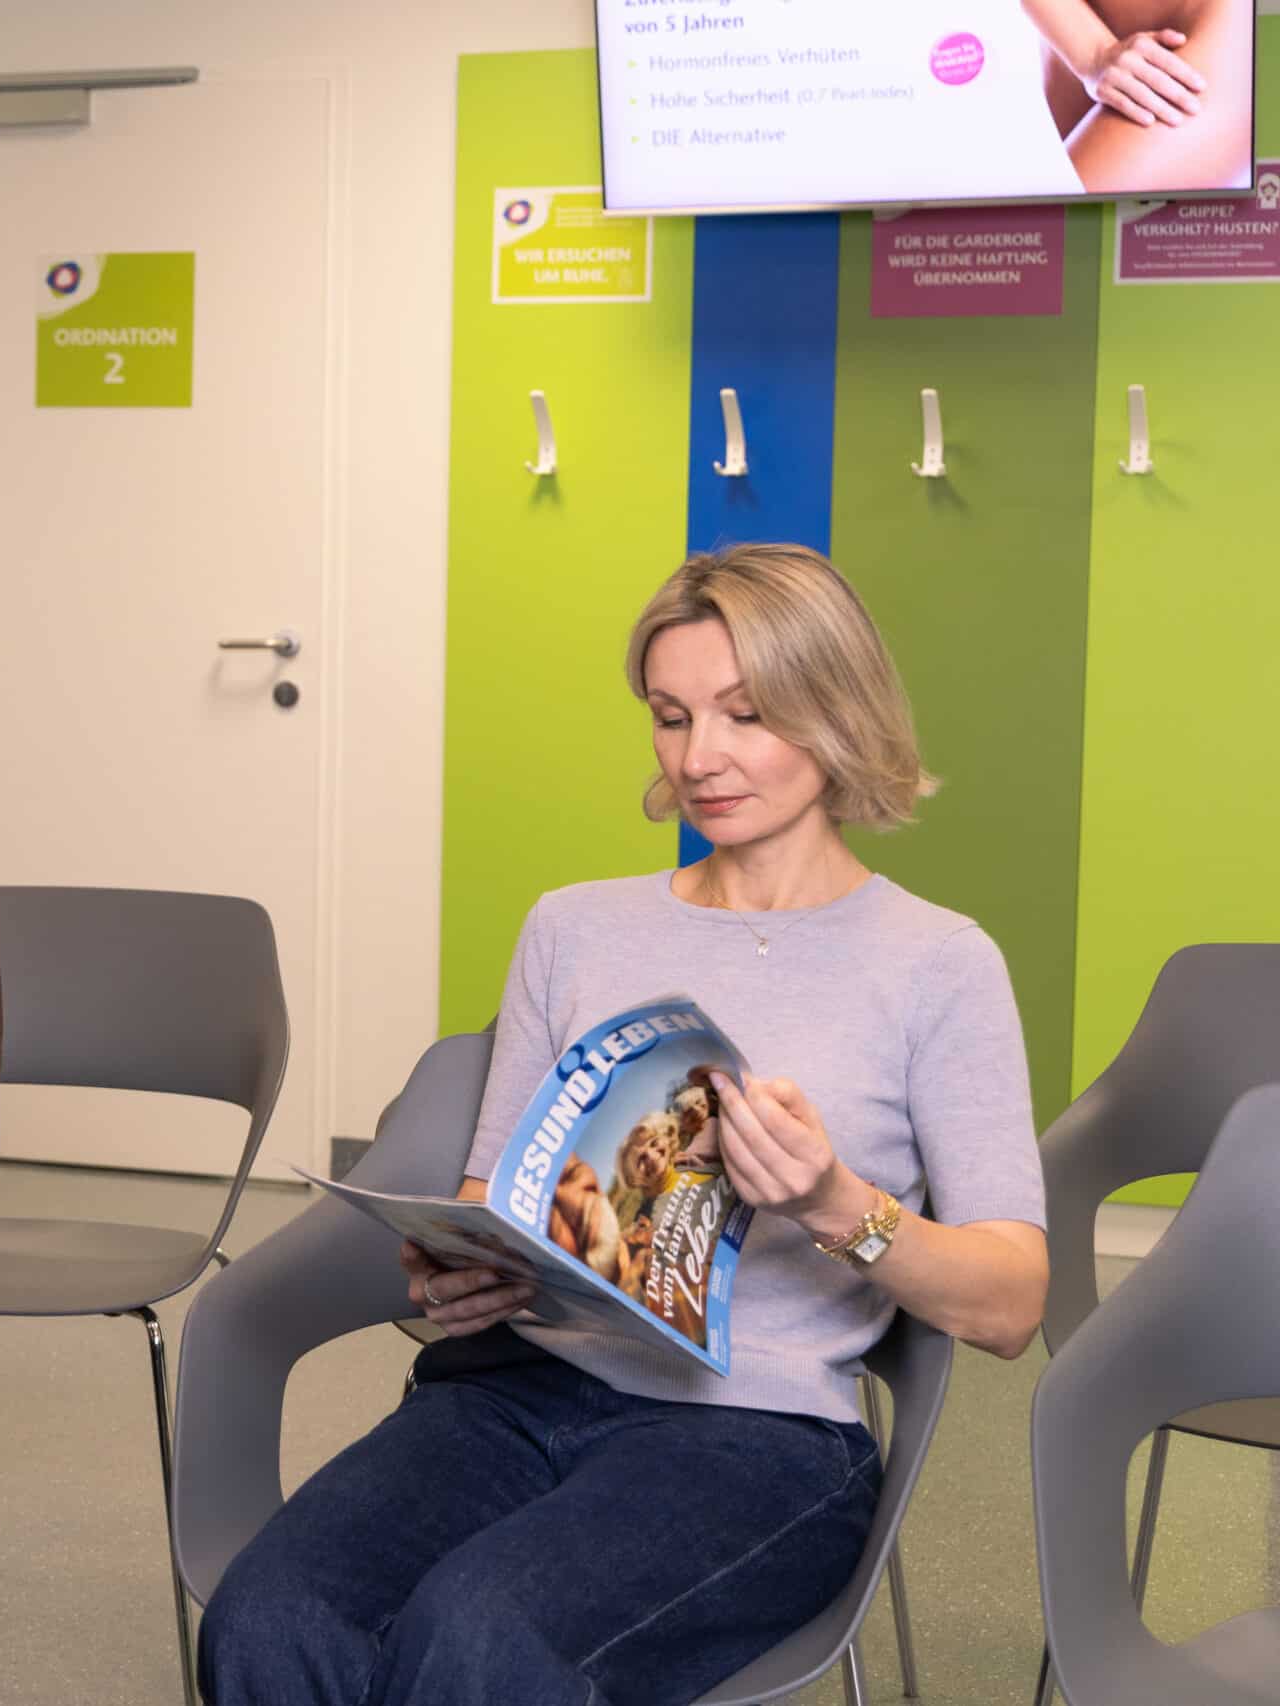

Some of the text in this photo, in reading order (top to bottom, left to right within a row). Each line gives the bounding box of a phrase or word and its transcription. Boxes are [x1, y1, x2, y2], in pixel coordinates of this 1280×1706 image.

[624, 13, 744, 34] von 5 Jahren
[649, 47, 860, 72] Hormonfreies Verhüten
[649, 92, 697, 110] Hohe
[704, 88, 790, 107] Sicherheit
[652, 128, 786, 147] DIE Alternative
[1179, 205, 1235, 218] GRIPPE?
[1134, 221, 1280, 237] VERKÜHLT? HUSTEN?
[894, 231, 1043, 249] FÜR DIE GARDEROBE
[514, 247, 632, 264] WIR ERSUCHEN
[888, 251, 1049, 268] WIRD KEINE HAFTUNG
[533, 269, 560, 283] UM
[913, 270, 1021, 288] ÜBERNOMMEN
[54, 326, 178, 347] ORDINATION
[104, 351, 126, 385] 2
[509, 1069, 597, 1225] GESUND
[587, 1012, 705, 1075] LEBEN
[646, 1172, 692, 1302] Der Traum
[663, 1183, 702, 1318] vom langen
